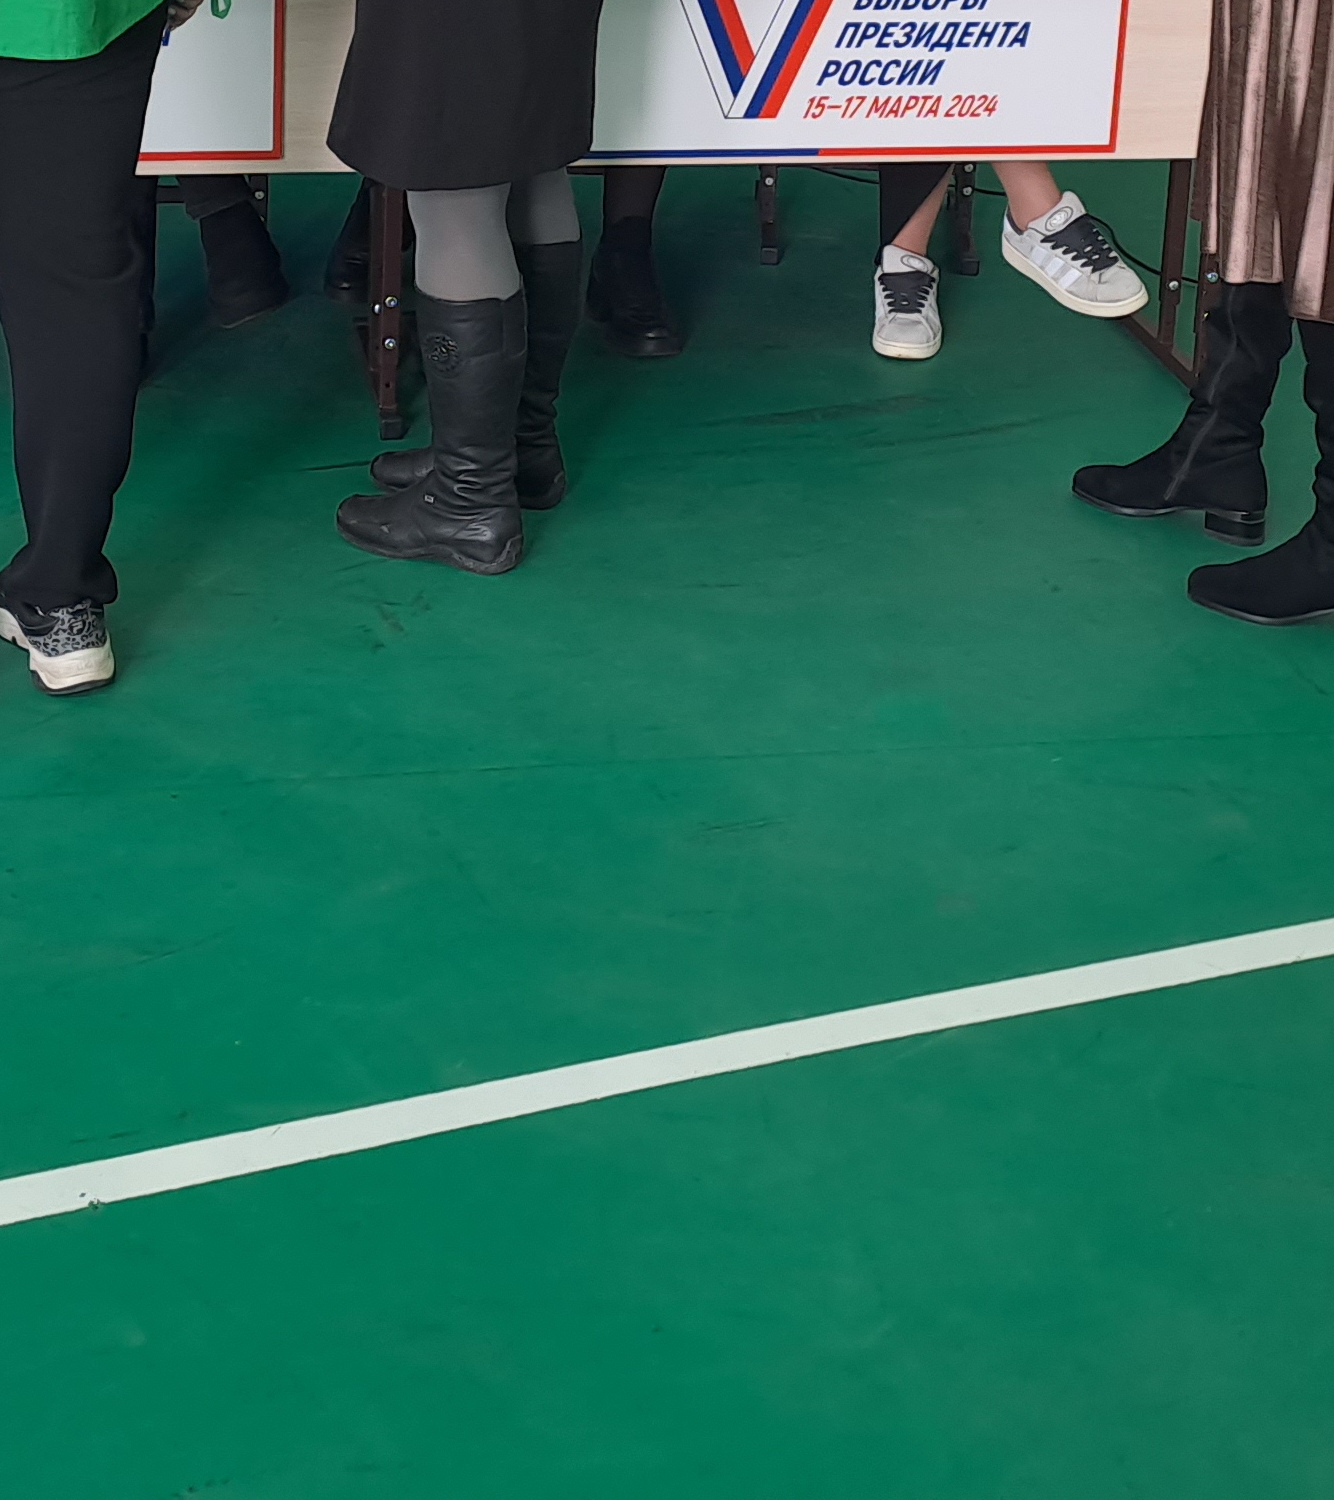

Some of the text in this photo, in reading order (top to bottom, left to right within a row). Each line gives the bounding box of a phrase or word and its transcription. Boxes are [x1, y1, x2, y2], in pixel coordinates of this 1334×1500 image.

[834, 21, 1032, 52] ПРЕЗИДЕНТА
[816, 58, 946, 87] РОССИИ
[865, 95, 943, 119] МАРТА
[943, 94, 1000, 118] 2024
